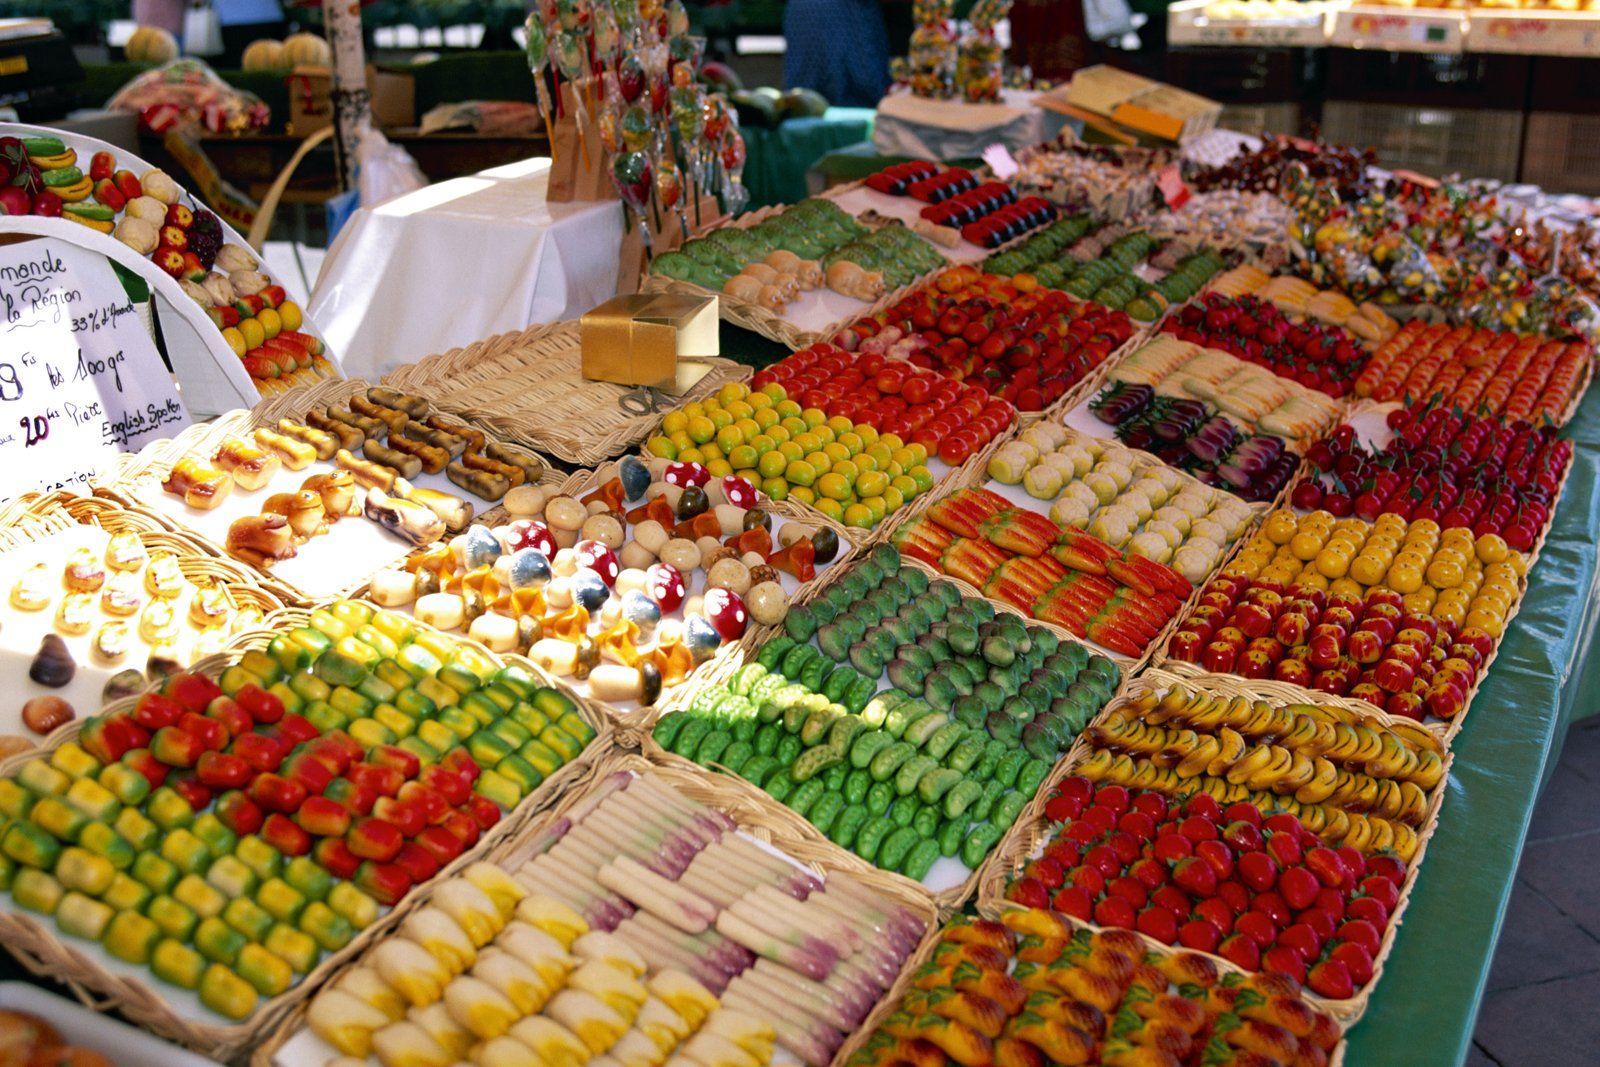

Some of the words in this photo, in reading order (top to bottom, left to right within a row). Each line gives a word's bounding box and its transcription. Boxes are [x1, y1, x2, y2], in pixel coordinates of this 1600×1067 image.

[21, 285, 82, 324] Région
[70, 308, 101, 333] 33%
[20, 415, 50, 448] 20
[102, 409, 146, 445] English
